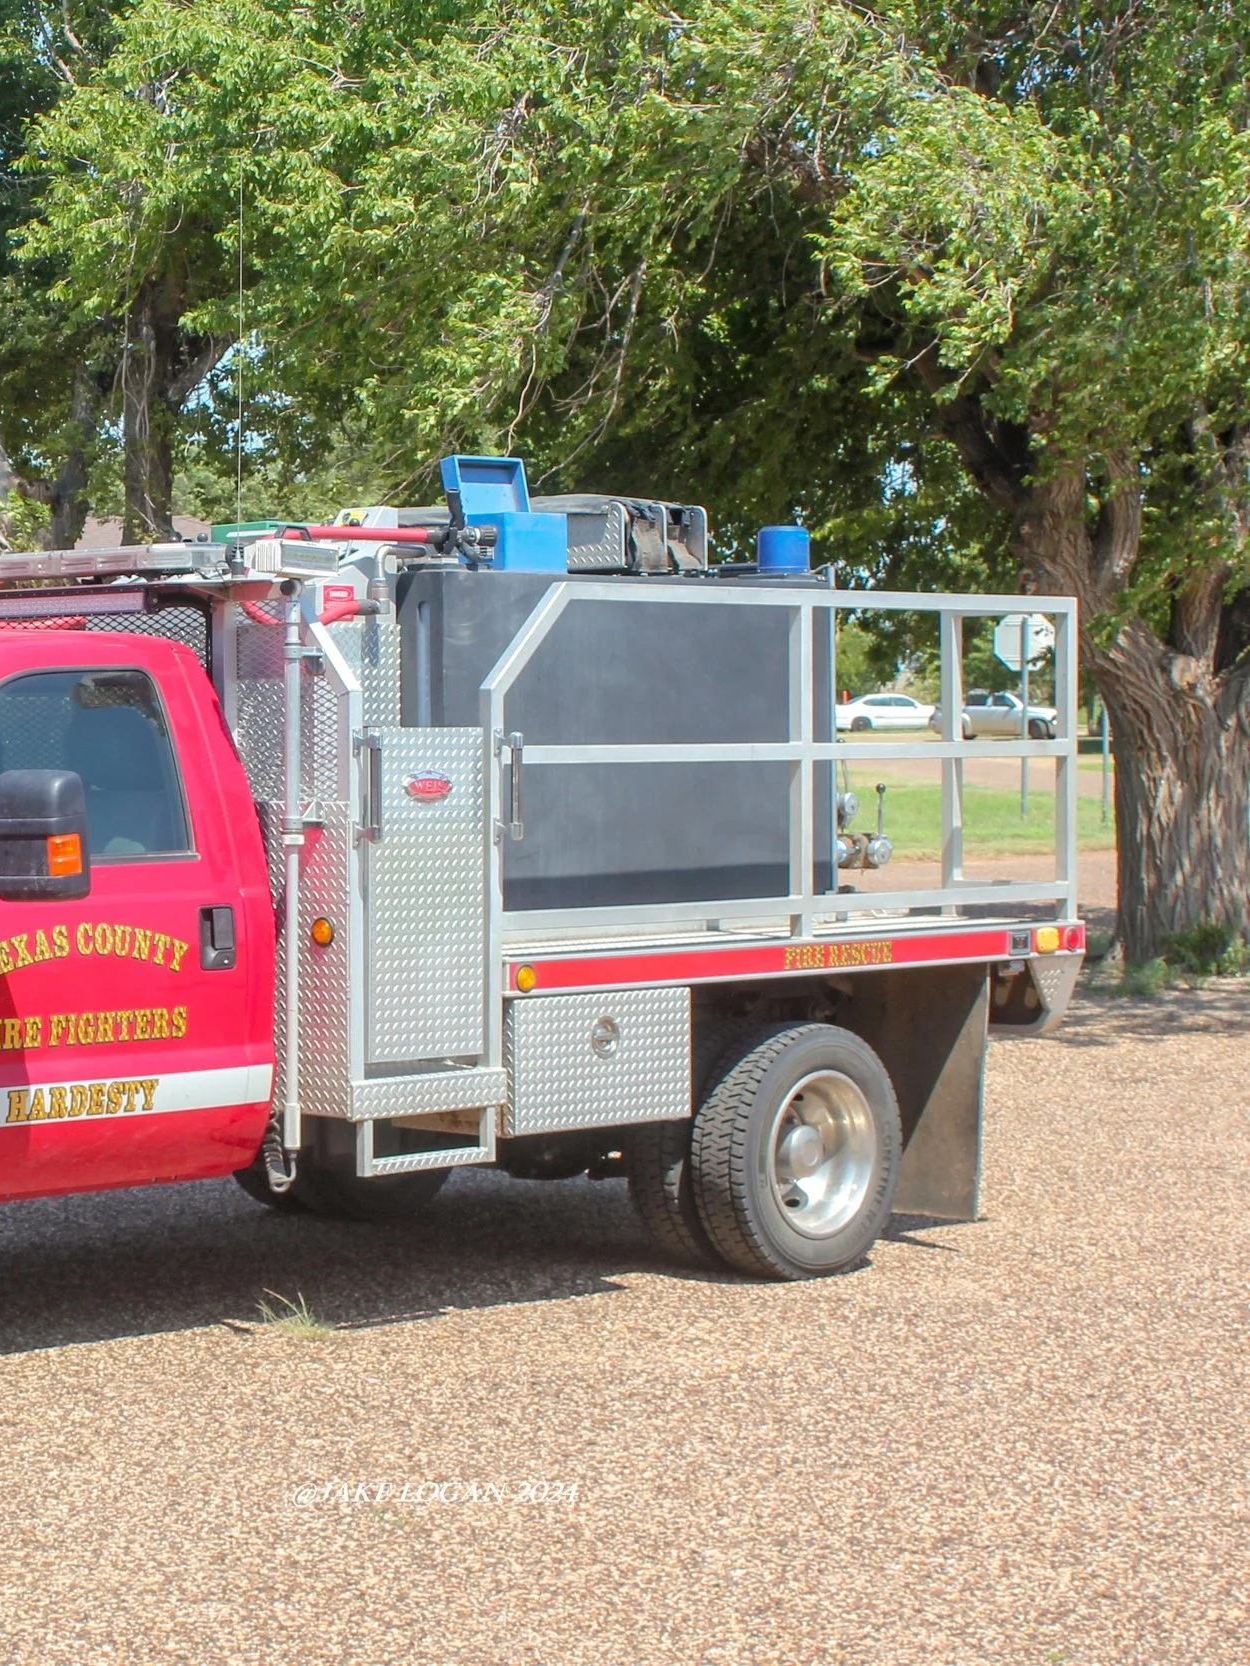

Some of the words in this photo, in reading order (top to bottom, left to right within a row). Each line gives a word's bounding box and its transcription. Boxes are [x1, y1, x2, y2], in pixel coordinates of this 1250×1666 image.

[76, 922, 189, 972] COUNTY
[784, 945, 825, 970] FIRE
[828, 941, 892, 967] RESCUE
[48, 1006, 188, 1046] FIGHTERS
[5, 1078, 160, 1123] HARDESTY
